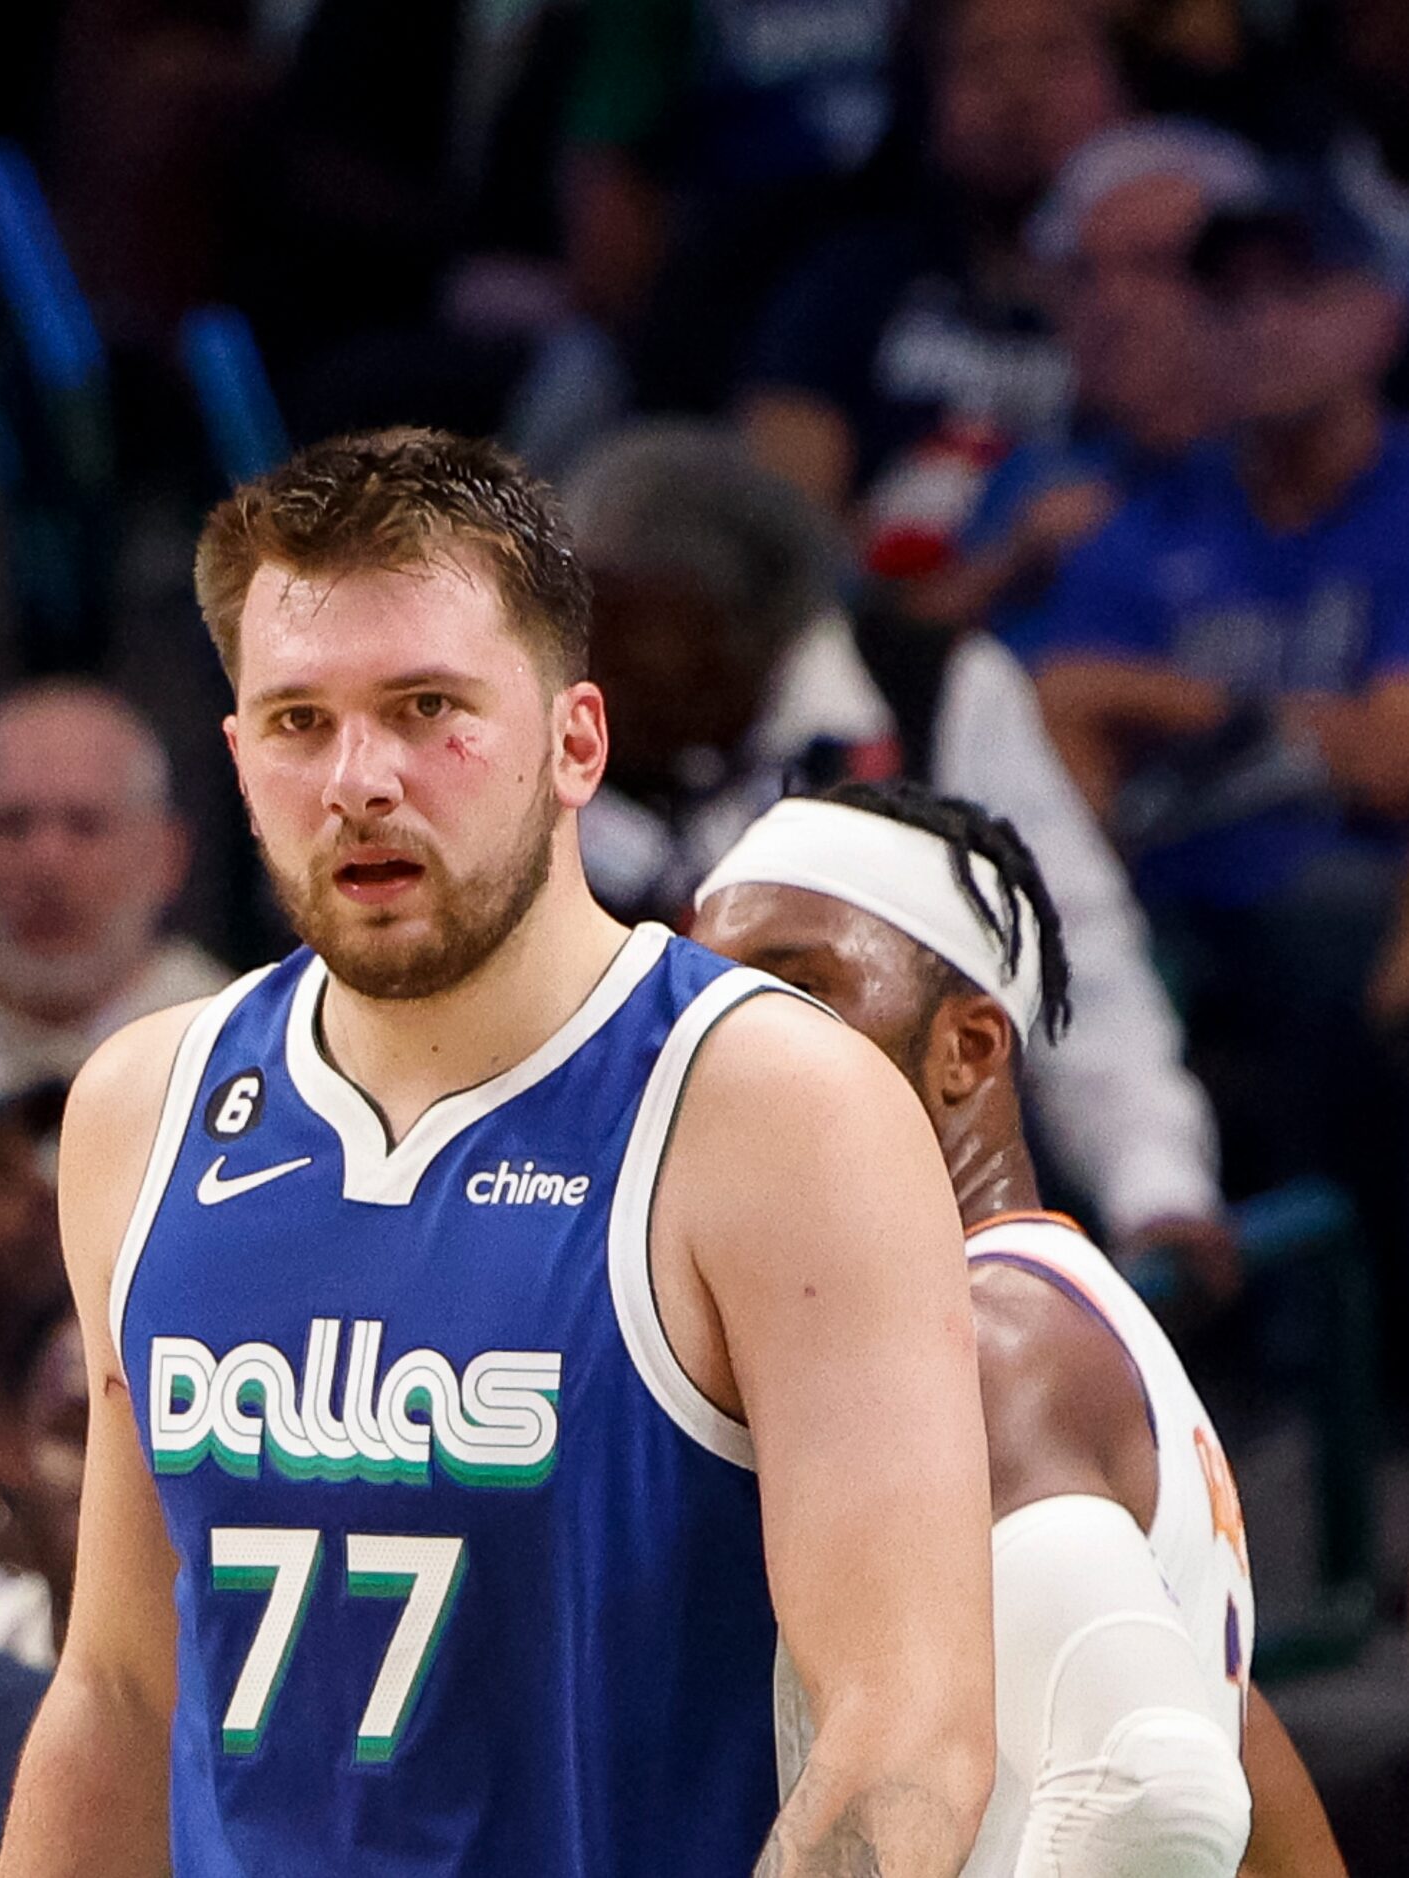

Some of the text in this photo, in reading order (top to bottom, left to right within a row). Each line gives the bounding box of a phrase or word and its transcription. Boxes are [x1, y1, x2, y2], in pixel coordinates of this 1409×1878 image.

[214, 1075, 262, 1135] 6
[465, 1161, 590, 1207] chime
[148, 1317, 563, 1487] Dallas
[210, 1527, 467, 1763] 77
